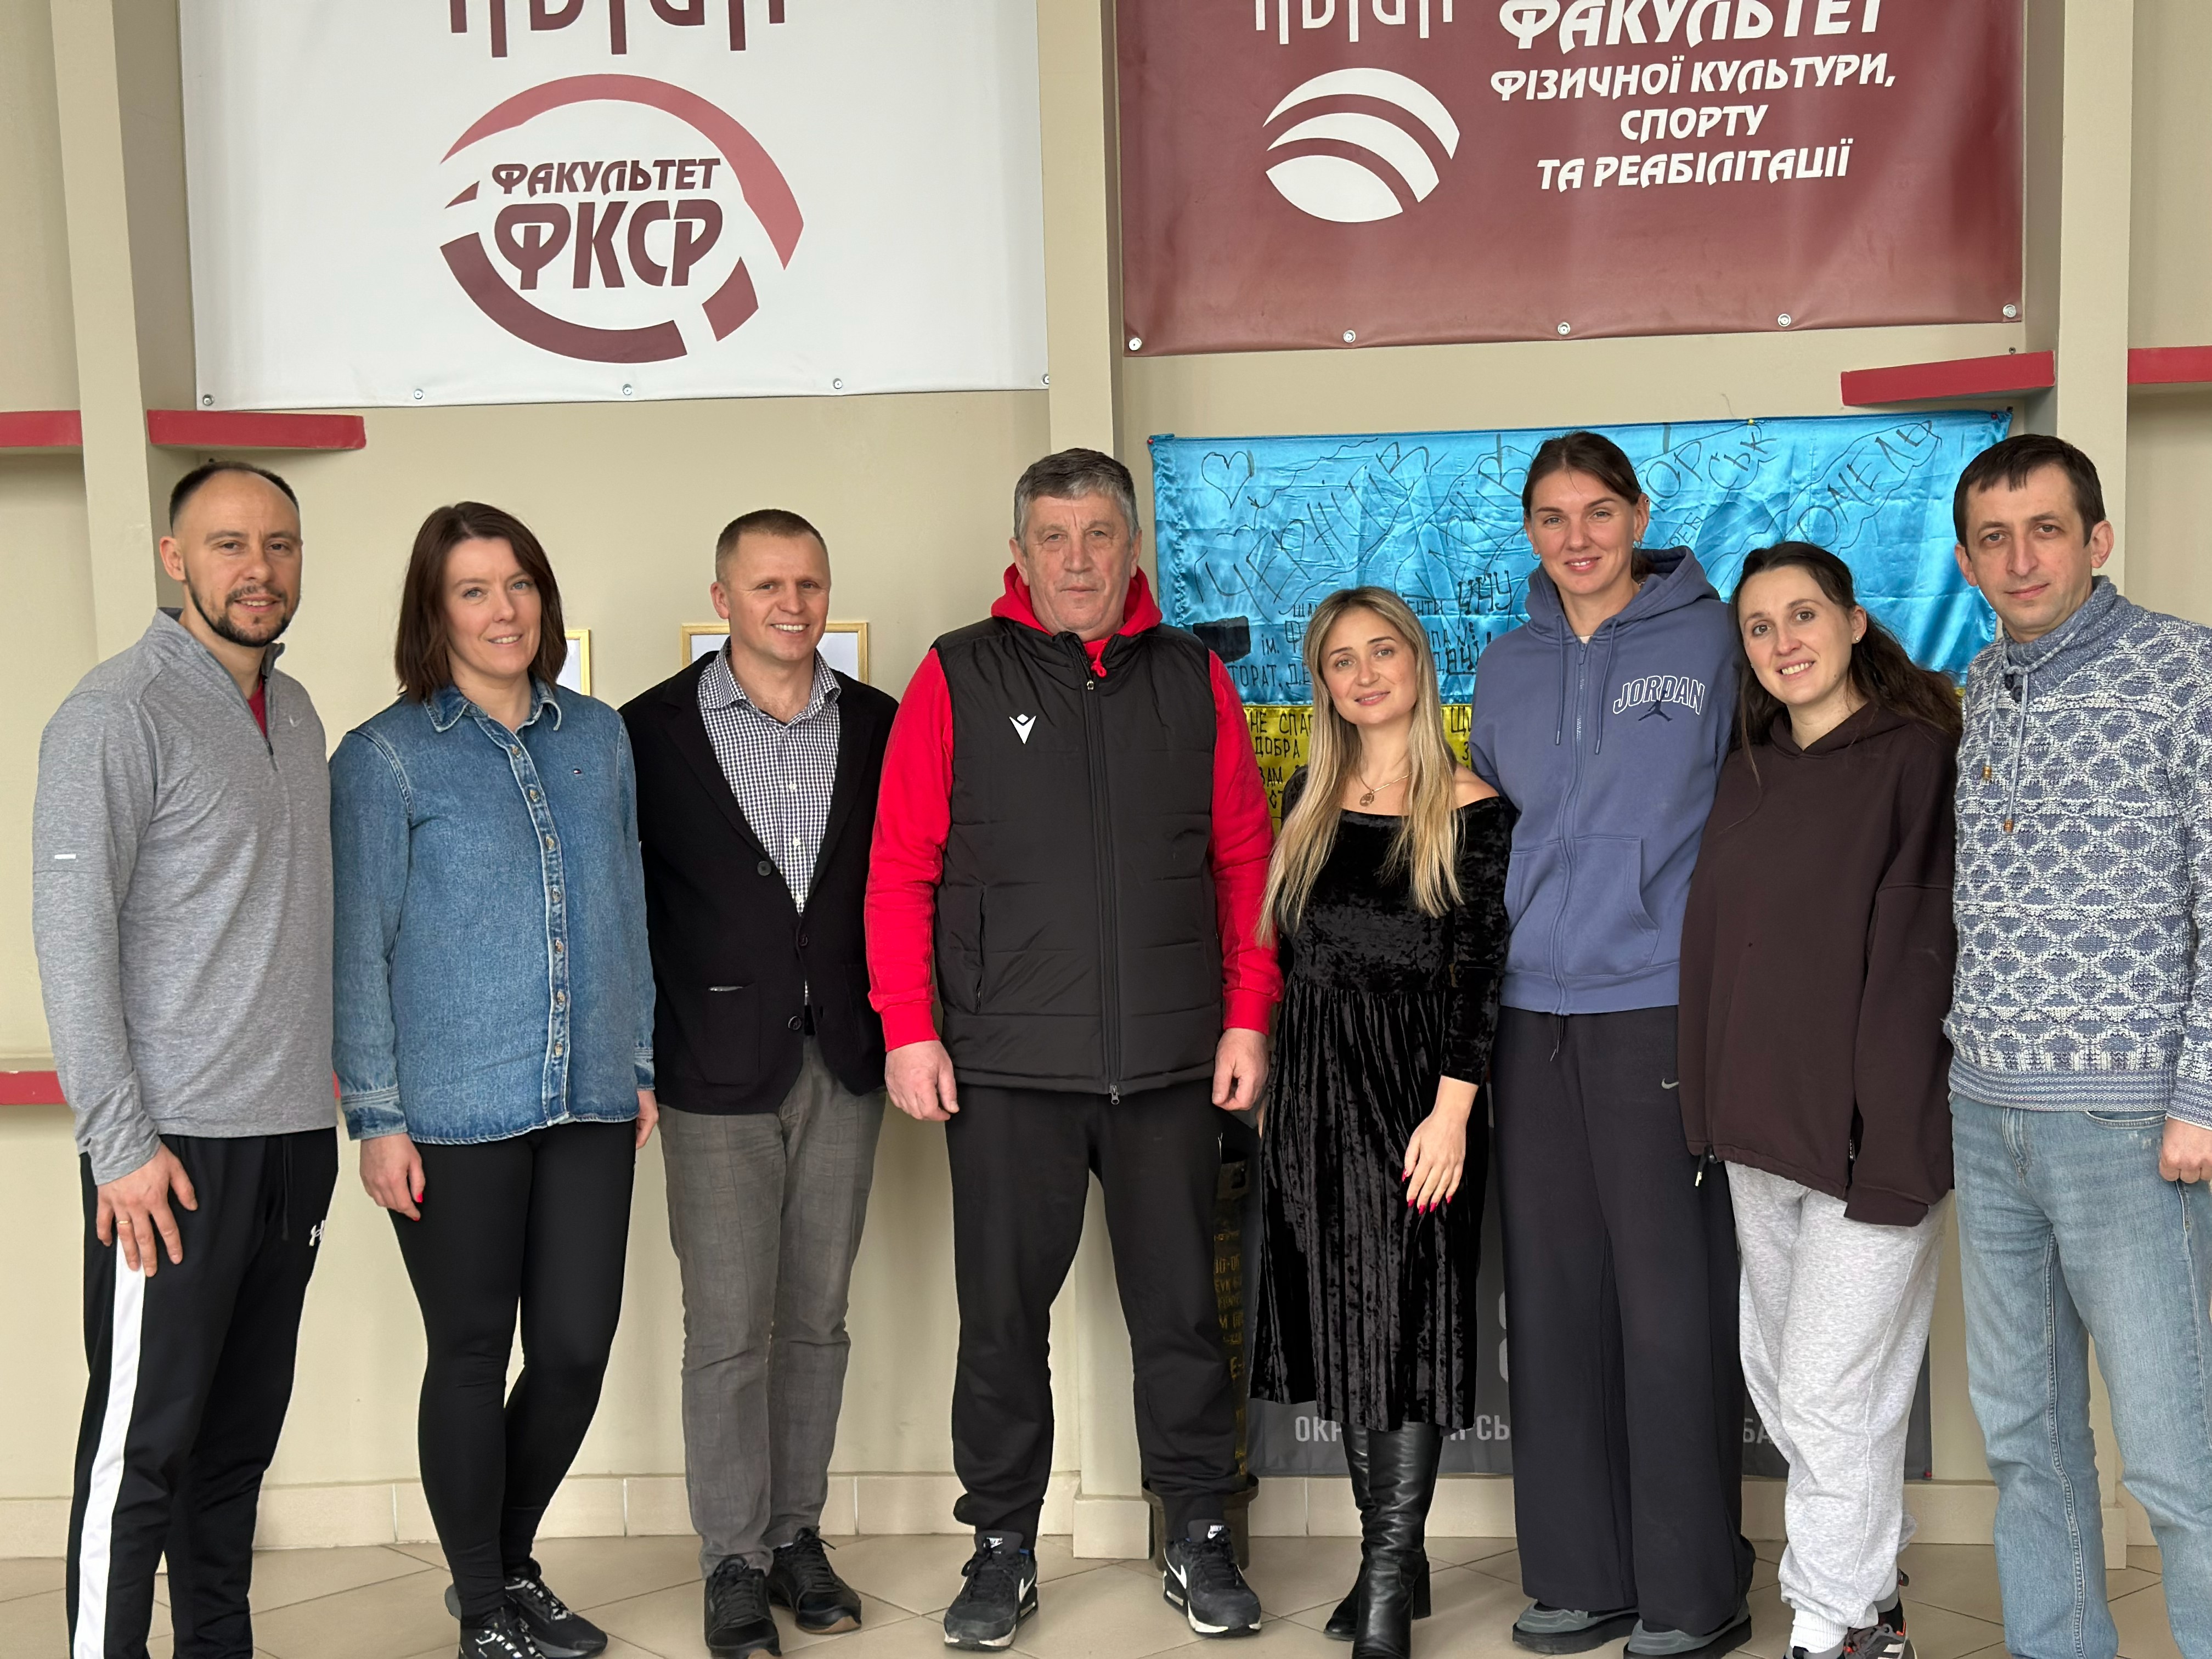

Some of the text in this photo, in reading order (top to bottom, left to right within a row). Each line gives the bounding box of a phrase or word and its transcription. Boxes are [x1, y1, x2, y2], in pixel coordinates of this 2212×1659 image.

[1491, 53, 1895, 101] ФІЗИЧНОЇ КУЛЬТУРИ,
[1620, 104, 1769, 144] СПОРТУ
[492, 158, 720, 197] ФАКУЛЬТЕТ
[1537, 138, 1853, 192] ТА РЕАБІЛІТАЦІЇ
[494, 199, 723, 290] ФКСР
[1612, 675, 1705, 715] JORDAN
[1255, 735, 1300, 759] ДОБРА
